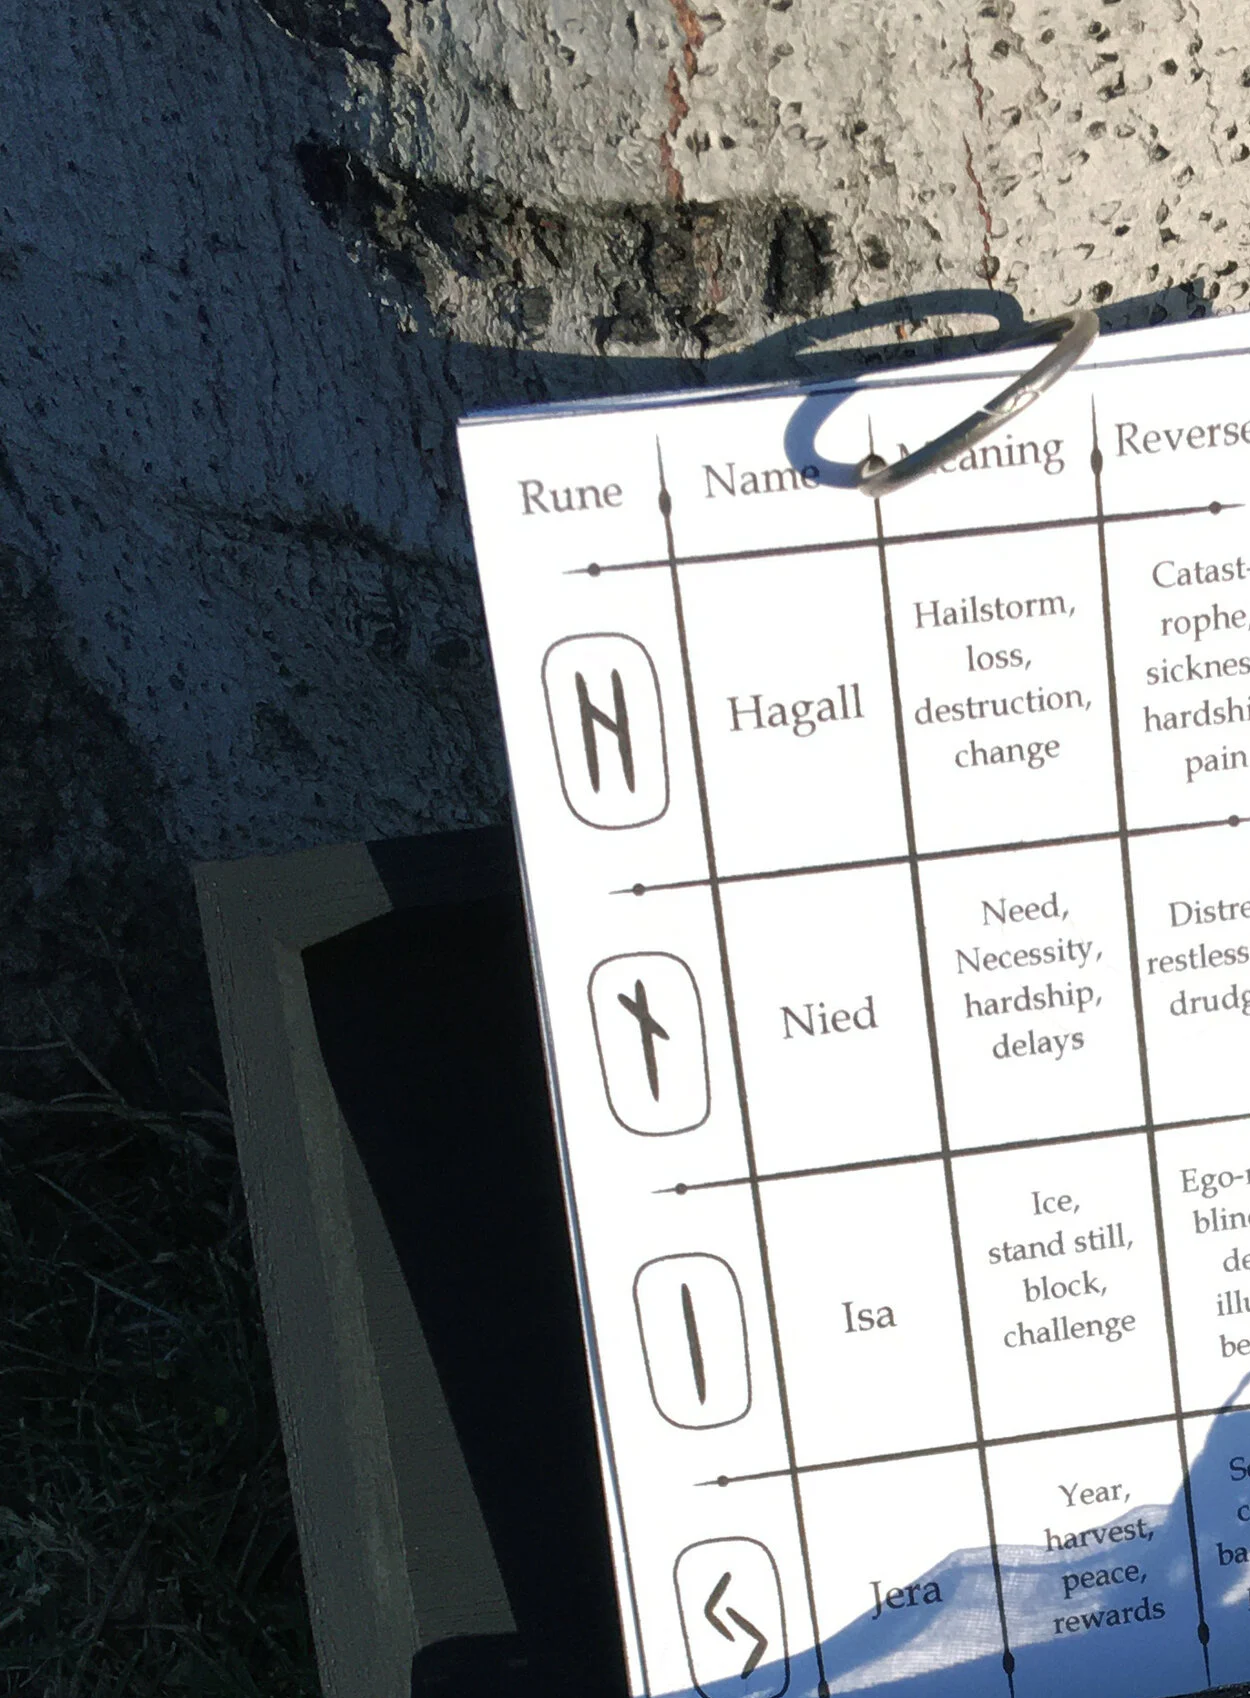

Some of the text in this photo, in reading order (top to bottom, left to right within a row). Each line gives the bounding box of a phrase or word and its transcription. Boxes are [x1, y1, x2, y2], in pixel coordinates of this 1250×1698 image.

[896, 432, 1065, 475] aning
[519, 480, 622, 514] Rune
[703, 462, 820, 499] Name
[914, 596, 1075, 628] Hailstorm,
[967, 645, 1031, 671] loss,
[727, 683, 864, 737] Hagall
[915, 687, 1091, 725] destruction,
[955, 740, 1060, 769] change
[1185, 746, 1248, 783] pain
[982, 892, 1068, 925] Need,
[956, 938, 1102, 974] Necessity,
[780, 995, 878, 1039] Nied
[964, 982, 1101, 1018] hardship,
[993, 1030, 1084, 1060] delays
[1032, 1192, 1079, 1215] Ice,
[989, 1223, 1132, 1264] stand still,
[1023, 1270, 1106, 1302] block,
[842, 1302, 897, 1333] Isa
[1004, 1315, 1135, 1347] challenge
[1057, 1482, 1131, 1508] Year,
[1044, 1517, 1155, 1553] harvest,
[1061, 1562, 1148, 1600] peace,
[868, 1579, 943, 1620] Jera
[1053, 1599, 1166, 1635] rewards
